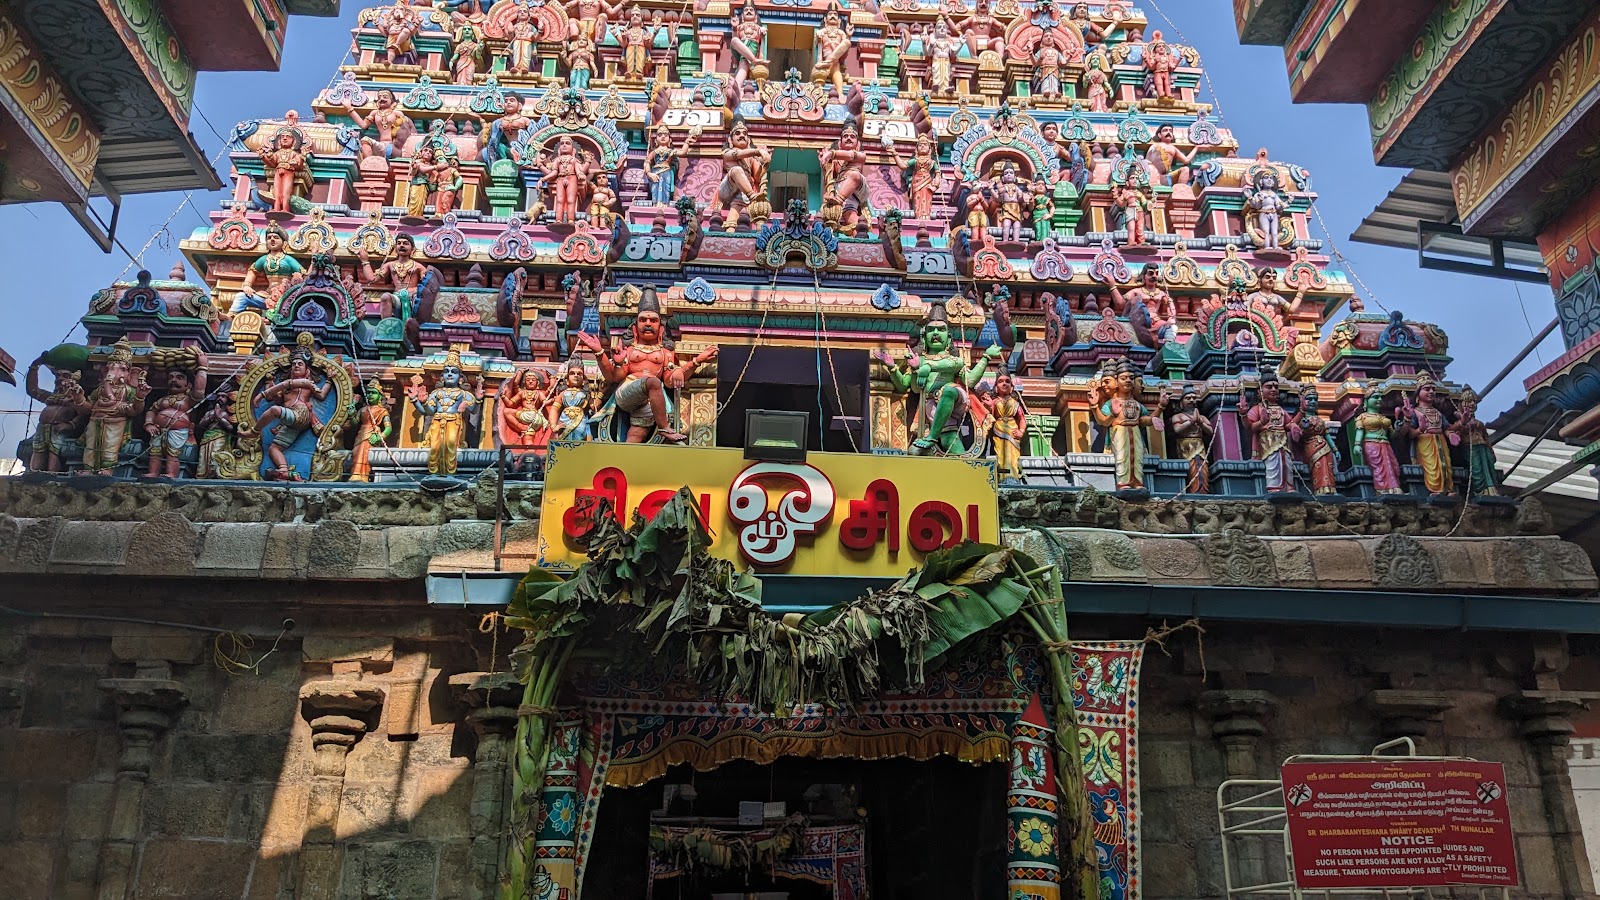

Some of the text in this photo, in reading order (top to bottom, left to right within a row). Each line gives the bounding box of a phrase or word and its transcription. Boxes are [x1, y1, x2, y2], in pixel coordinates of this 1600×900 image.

[839, 478, 979, 553] சிவ
[1371, 780, 1425, 791] அறிவிப்பு
[1381, 835, 1435, 846] NOTICE
[1320, 848, 1331, 856] NO
[1333, 848, 1361, 856] PERSON
[1380, 847, 1400, 855] BEEN
[1401, 846, 1442, 855] APPOINTED
[1469, 845, 1485, 853] AND
[1315, 859, 1336, 867] SUCH
[1355, 858, 1389, 866] PERSONS
[1390, 857, 1406, 865] ARE
[1407, 857, 1422, 865] NOT
[1464, 854, 1492, 863] SAFETY
[1303, 868, 1341, 877] MEASURE,
[1342, 868, 1370, 876] TAKING
[1371, 866, 1425, 875] PHOTOGRAPHS
[1426, 866, 1441, 874] ARE
[1462, 864, 1508, 874] PROHIBITED
